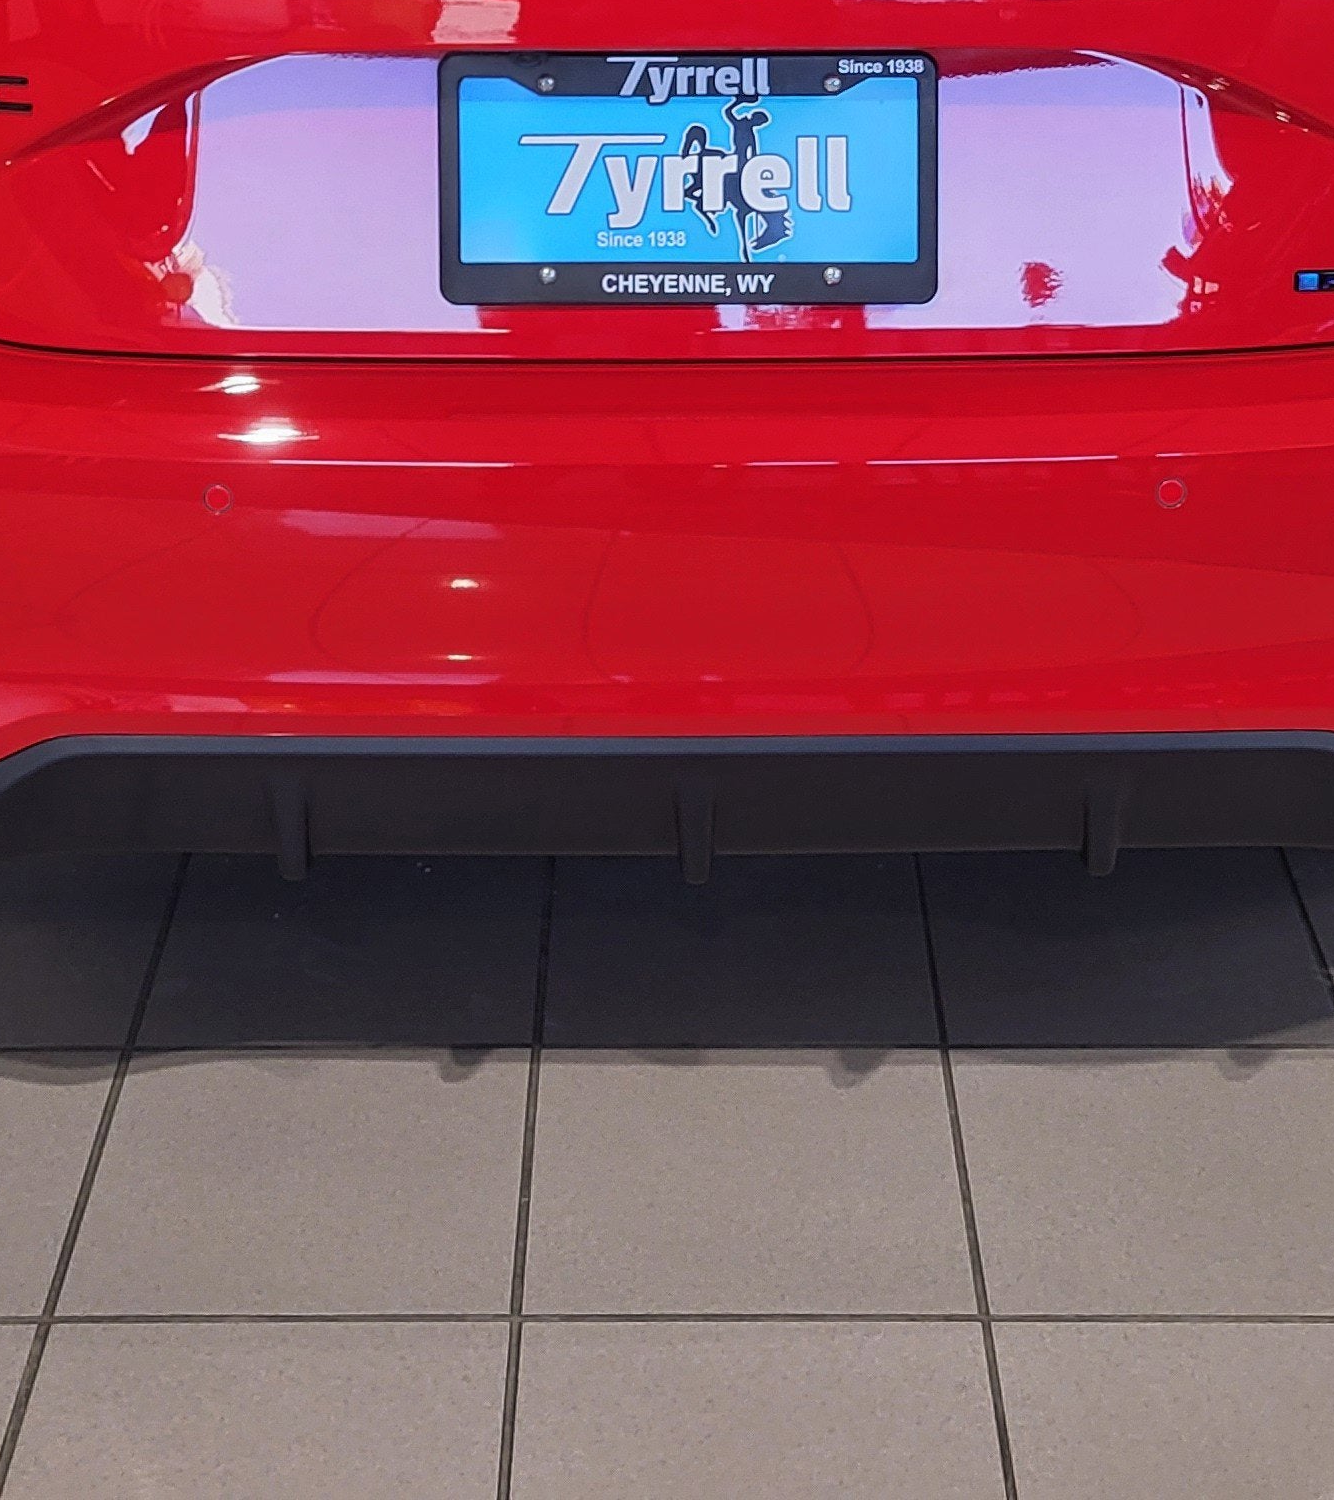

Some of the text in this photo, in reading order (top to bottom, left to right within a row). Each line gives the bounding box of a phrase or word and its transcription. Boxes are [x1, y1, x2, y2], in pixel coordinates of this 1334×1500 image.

[838, 58, 924, 74] Since 1938
[606, 56, 771, 104] Tyrrell
[518, 133, 852, 229] Tyrrell
[596, 231, 687, 249] Since 1938
[601, 273, 776, 297] CHEYENNE, WY
